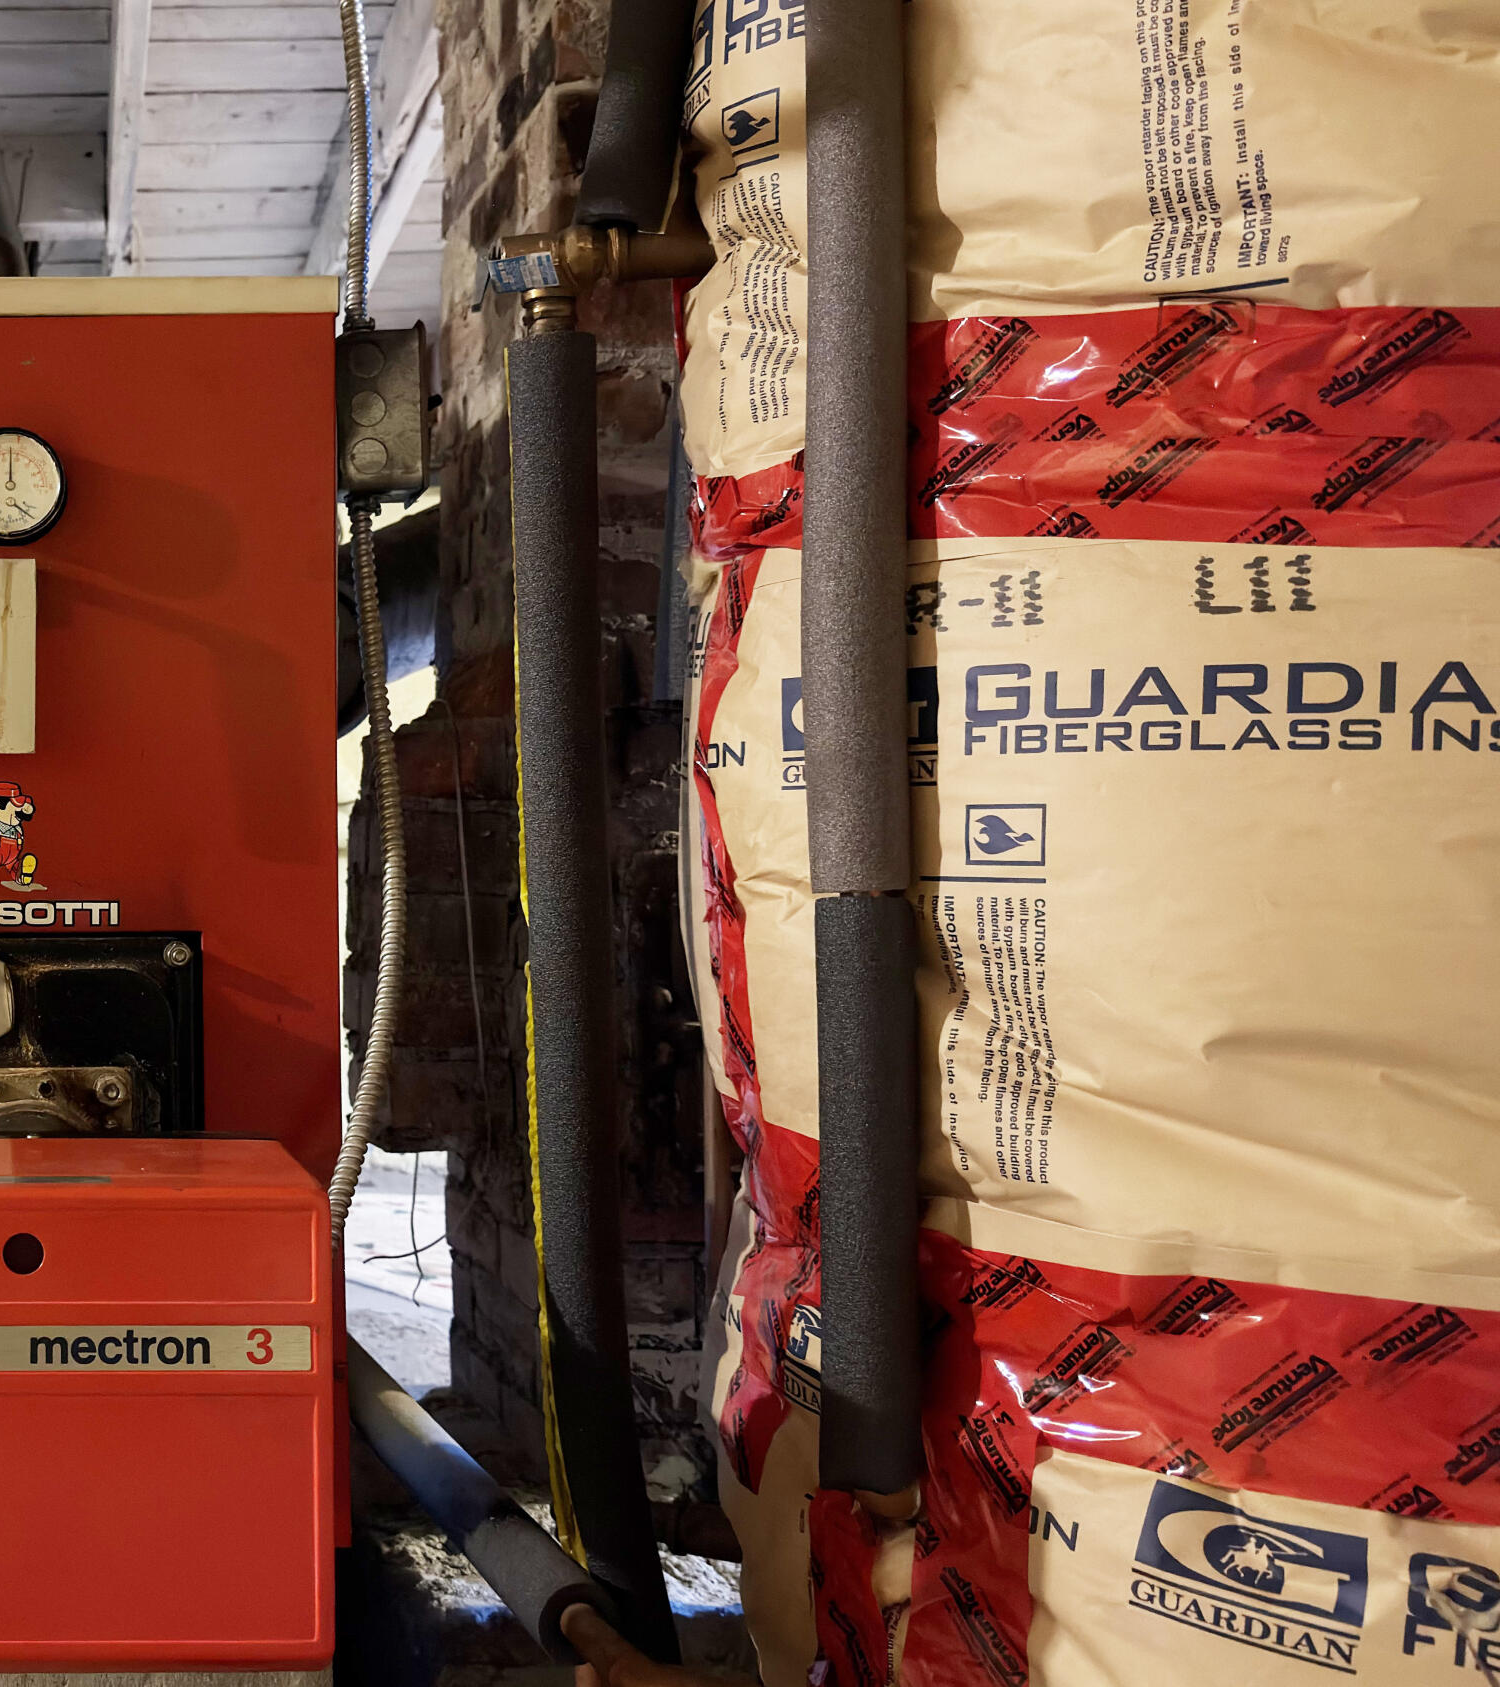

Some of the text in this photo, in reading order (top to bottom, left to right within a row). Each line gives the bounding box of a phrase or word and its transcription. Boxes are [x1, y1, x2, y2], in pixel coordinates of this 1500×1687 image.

[1135, 21, 1164, 282] CAUTION: The vapor retarder facing on this
[1148, 15, 1179, 280] will burn and must not be left exposed. It must be
[1162, 17, 1194, 278] with gypsum board or other code approved
[1177, 21, 1208, 276] material. To prevent a fire, keep open flames
[1192, 37, 1222, 274] sources of ignition away from the facing.
[1228, 23, 1257, 268] IMPORTANT: Install this side of
[1254, 149, 1272, 266] toward living space.
[743, 289, 751, 313] from
[748, 179, 758, 202] with
[759, 380, 769, 423] building
[752, 293, 761, 318] keep
[770, 367, 780, 379] be
[749, 398, 759, 424] other
[769, 380, 780, 420] covered
[780, 377, 790, 417] product
[965, 661, 1497, 721] GUARDIA
[965, 719, 1381, 755] FIBERGLASS
[931, 895, 942, 932] toward
[990, 896, 1001, 945] material.
[1004, 897, 1015, 922] with
[1019, 897, 1030, 917] will
[1003, 925, 1017, 971] gypsum
[1019, 919, 1029, 944] burn
[1034, 899, 1047, 967] CAUTION:
[992, 946, 1003, 960] To
[1019, 946, 1030, 966] and
[995, 960, 1010, 1003] prevent
[1010, 974, 1022, 1007] board
[1022, 968, 1032, 995] must
[1036, 970, 1045, 991] The
[976, 896, 1001, 1103] sources of ignition away the facing.
[1003, 1004, 1011, 1012] a
[1024, 997, 1035, 1015] not
[1037, 994, 1048, 1027] vapor
[1005, 1013, 1014, 1035] fire,
[1015, 1010, 1023, 1023] or
[1027, 1015, 1037, 1030] be
[947, 1029, 959, 1052] this
[1031, 1030, 1042, 1047] left
[946, 1058, 956, 1085] side
[998, 1060, 1009, 1084] open
[1015, 1051, 1027, 1078] code
[949, 1092, 959, 1105] of
[994, 1086, 1007, 1123] flames
[1010, 1080, 1023, 1131] approved
[1025, 1095, 1037, 1121] must
[1043, 1098, 1054, 1112] on
[949, 1112, 970, 1171] Insultion
[995, 1126, 1005, 1148] and
[1024, 1123, 1035, 1137] be
[1040, 1115, 1052, 1136] this
[996, 1150, 1008, 1180] other
[1009, 1134, 1021, 1181] building
[1024, 1139, 1035, 1183] covered
[1038, 1139, 1049, 1184] product
[29, 1328, 274, 1365] mectron 3
[1022, 1325, 1121, 1403] VentureTape
[1211, 1355, 1338, 1443] VentureTape
[1130, 1579, 1358, 1664] GUARDIAN
